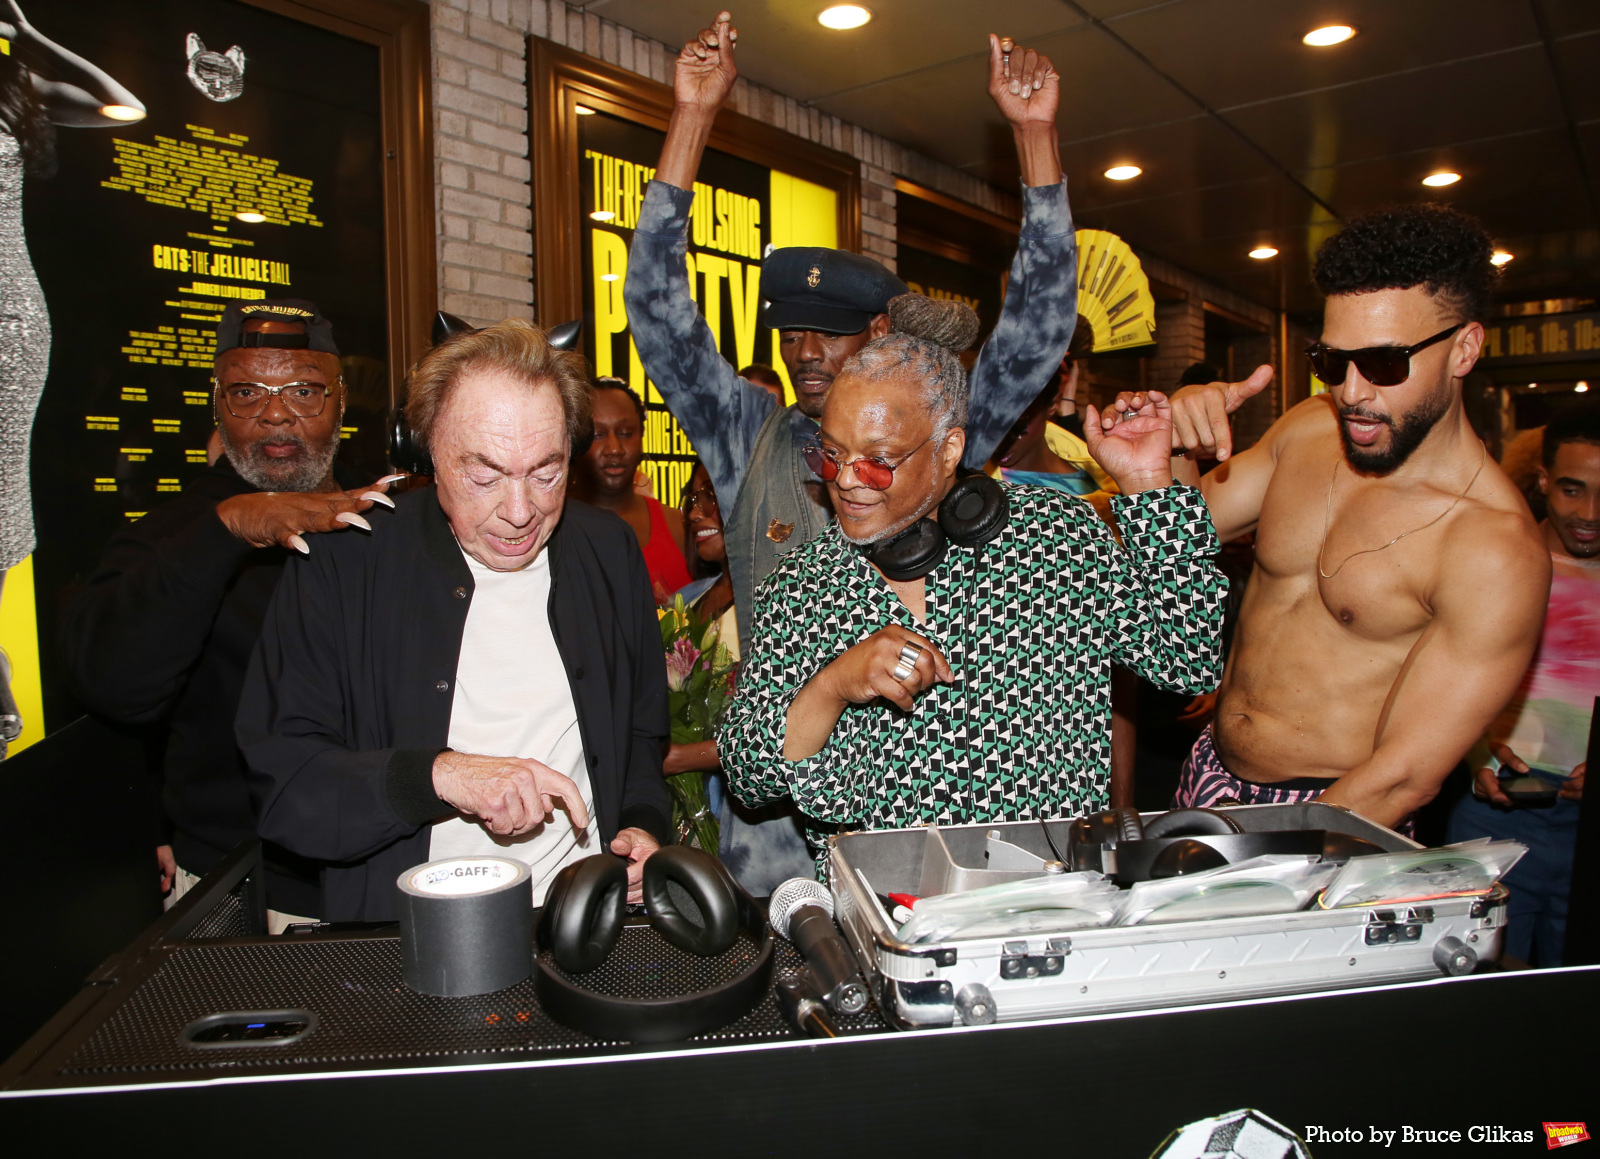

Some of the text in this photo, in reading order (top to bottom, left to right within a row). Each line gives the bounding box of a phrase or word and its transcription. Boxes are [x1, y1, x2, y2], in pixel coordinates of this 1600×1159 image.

[585, 149, 761, 260] "THERE' ULSING
[191, 250, 210, 275] THE
[210, 253, 270, 283] JELLICLE
[269, 261, 291, 285] BALL
